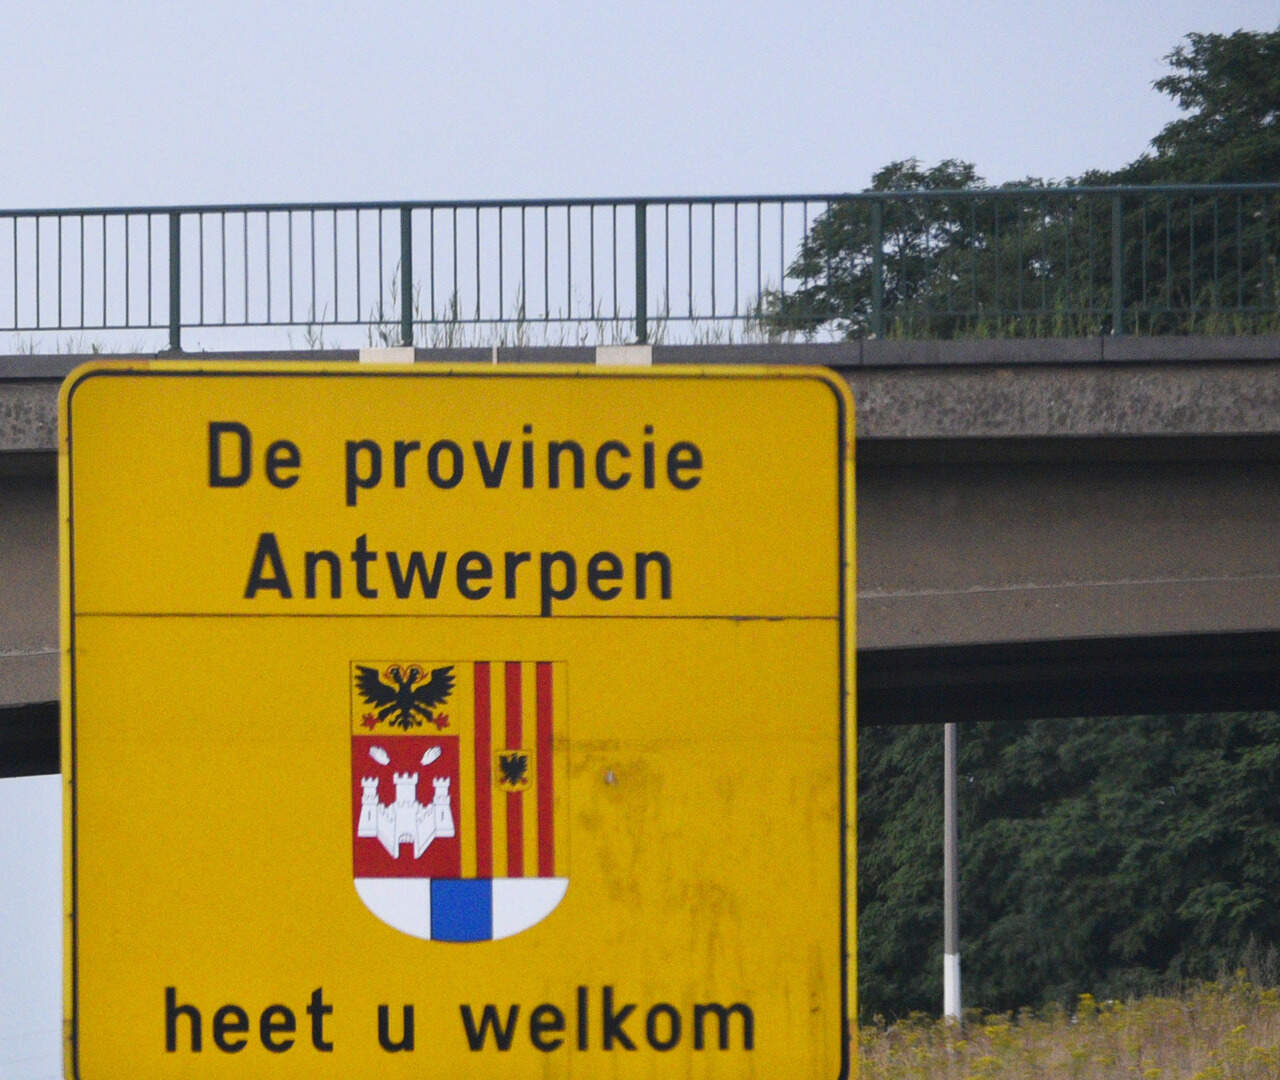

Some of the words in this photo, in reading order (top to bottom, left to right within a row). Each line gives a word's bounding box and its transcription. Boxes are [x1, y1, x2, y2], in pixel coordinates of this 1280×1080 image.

[207, 420, 302, 489] De
[344, 424, 704, 507] provincie
[244, 531, 673, 617] Antwerpen
[164, 986, 334, 1054] heet
[377, 1003, 416, 1053] u
[459, 985, 756, 1053] welkom
